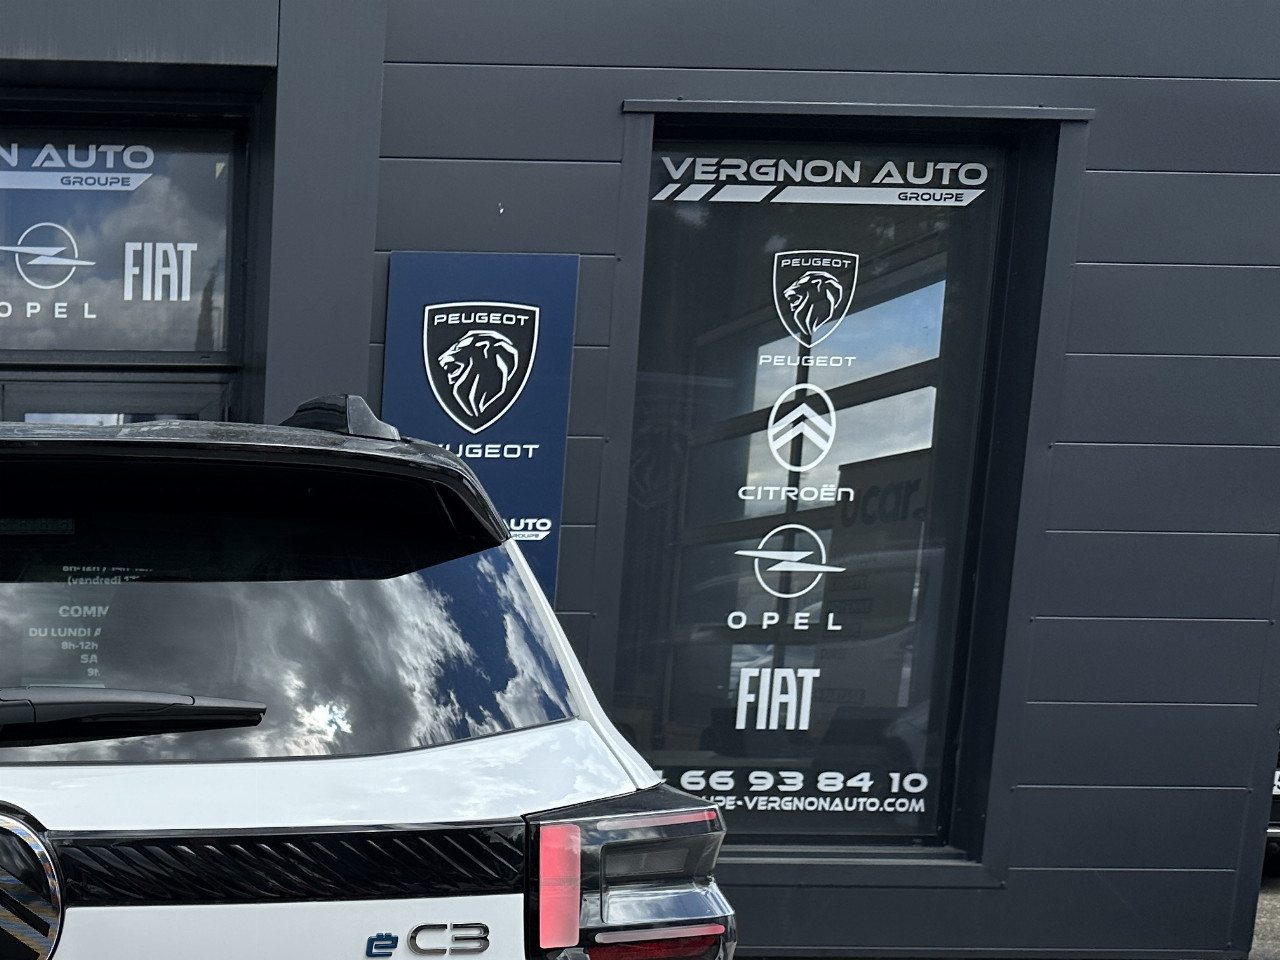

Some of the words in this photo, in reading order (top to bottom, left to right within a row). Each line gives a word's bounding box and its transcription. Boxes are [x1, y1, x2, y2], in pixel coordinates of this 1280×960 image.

[31, 143, 155, 169] AUTO
[661, 157, 861, 183] VERGNON
[872, 161, 988, 186] AUTO
[60, 175, 131, 187] GROUPE
[897, 191, 965, 202] GROUPE
[124, 242, 198, 301] FIAT
[781, 257, 852, 269] PEUGEOT
[433, 312, 530, 327] PEUGEOT
[758, 354, 857, 367] PEUGEOT
[727, 611, 842, 631] OPEL
[28, 628, 48, 637] DU
[50, 628, 91, 637] LUNDI
[735, 667, 820, 731] FIAT
[679, 769, 735, 791] 66
[748, 770, 804, 792] 93
[817, 771, 874, 793] 84
[889, 772, 928, 793] 10
